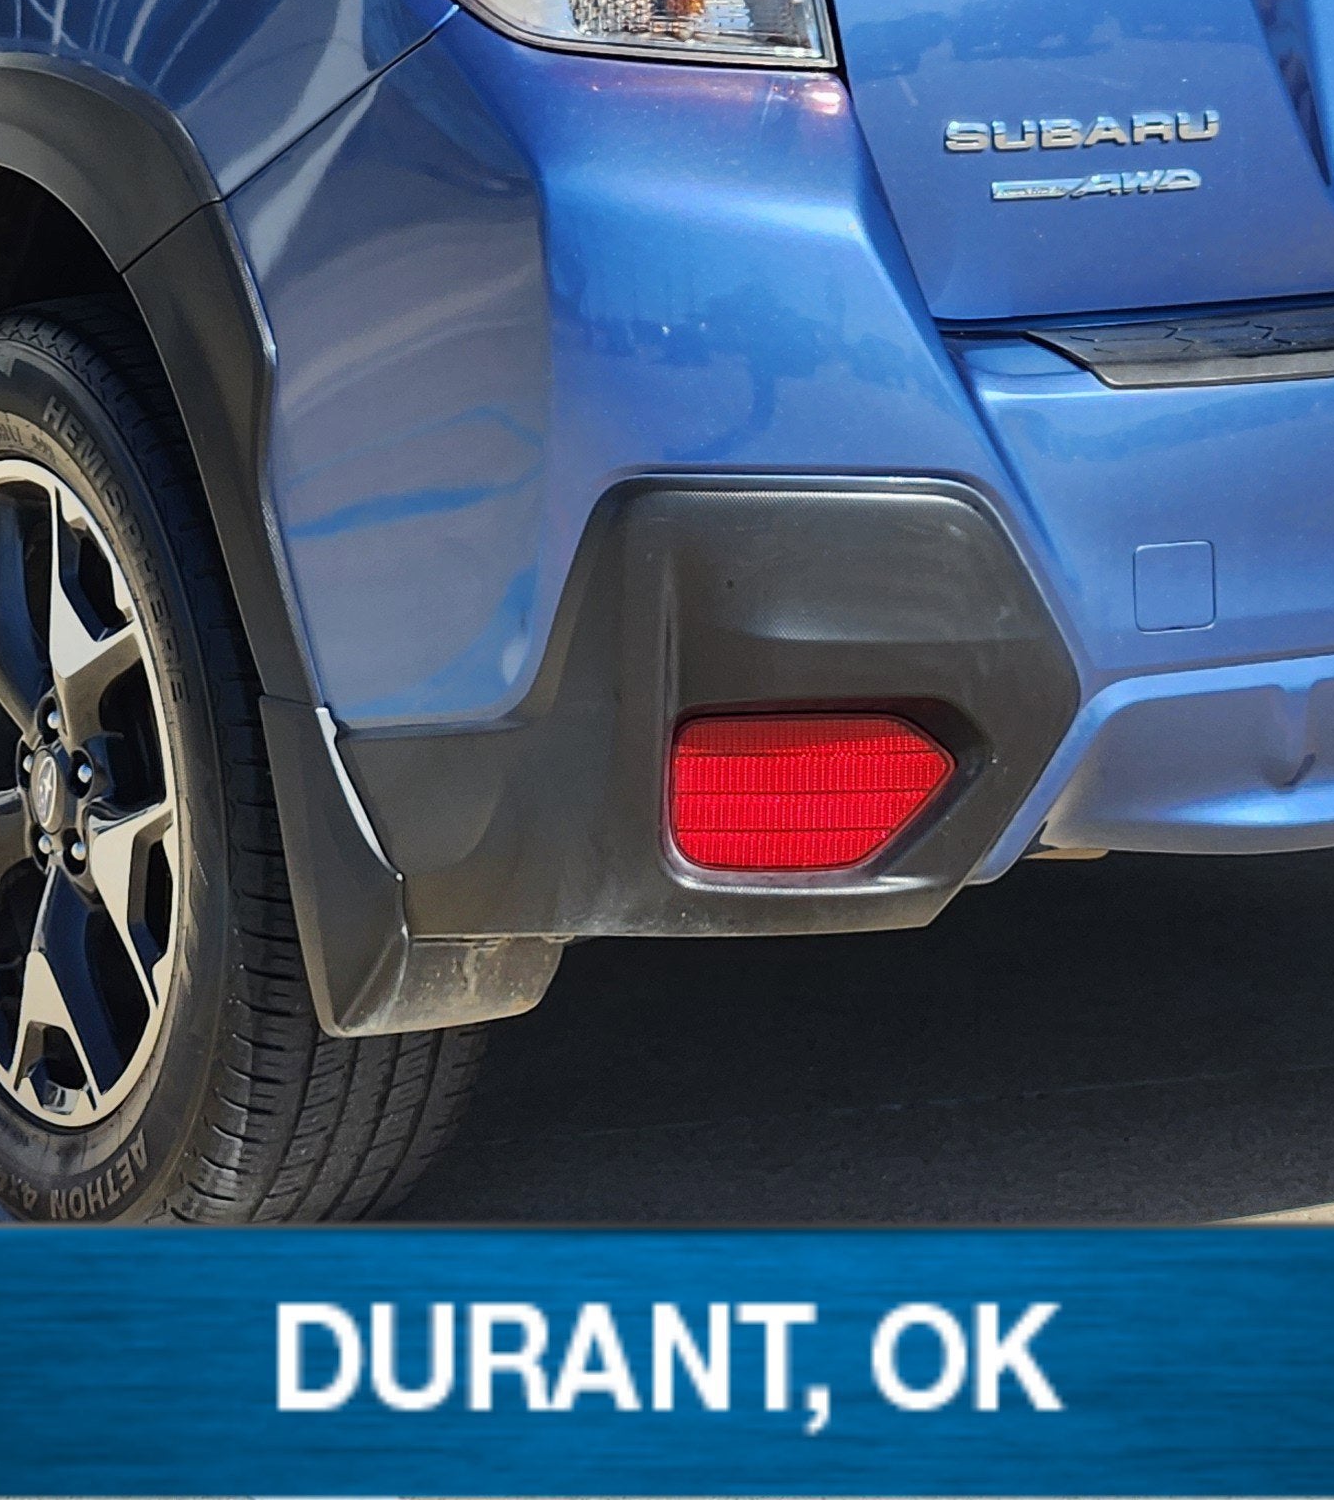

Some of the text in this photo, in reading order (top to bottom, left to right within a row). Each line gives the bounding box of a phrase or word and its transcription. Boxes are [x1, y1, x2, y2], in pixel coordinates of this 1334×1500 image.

[944, 109, 1221, 152] SUBARU
[1069, 167, 1202, 199] AWD
[47, 1127, 149, 1221] AETHON
